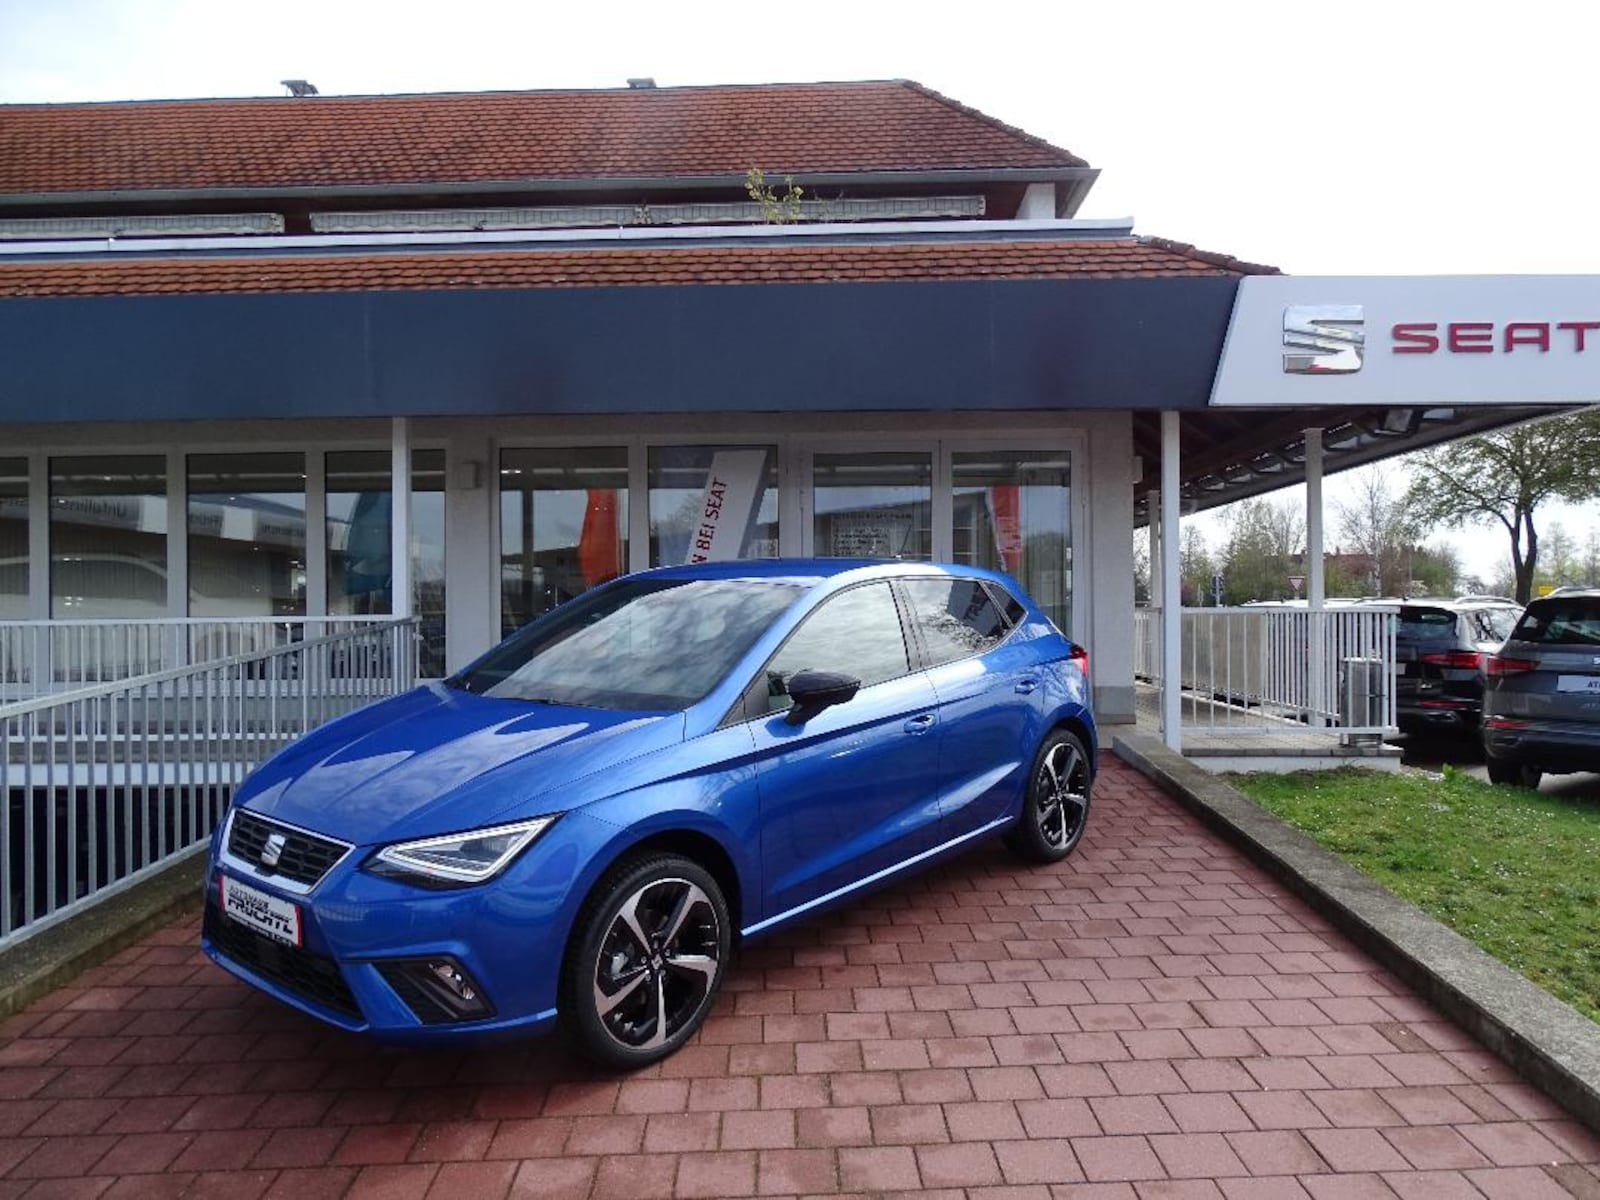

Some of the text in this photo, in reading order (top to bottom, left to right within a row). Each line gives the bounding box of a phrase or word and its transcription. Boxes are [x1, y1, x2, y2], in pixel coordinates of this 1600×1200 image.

[1391, 322, 1600, 353] SEAT
[705, 476, 727, 521] SEAT
[696, 523, 716, 550] BEI
